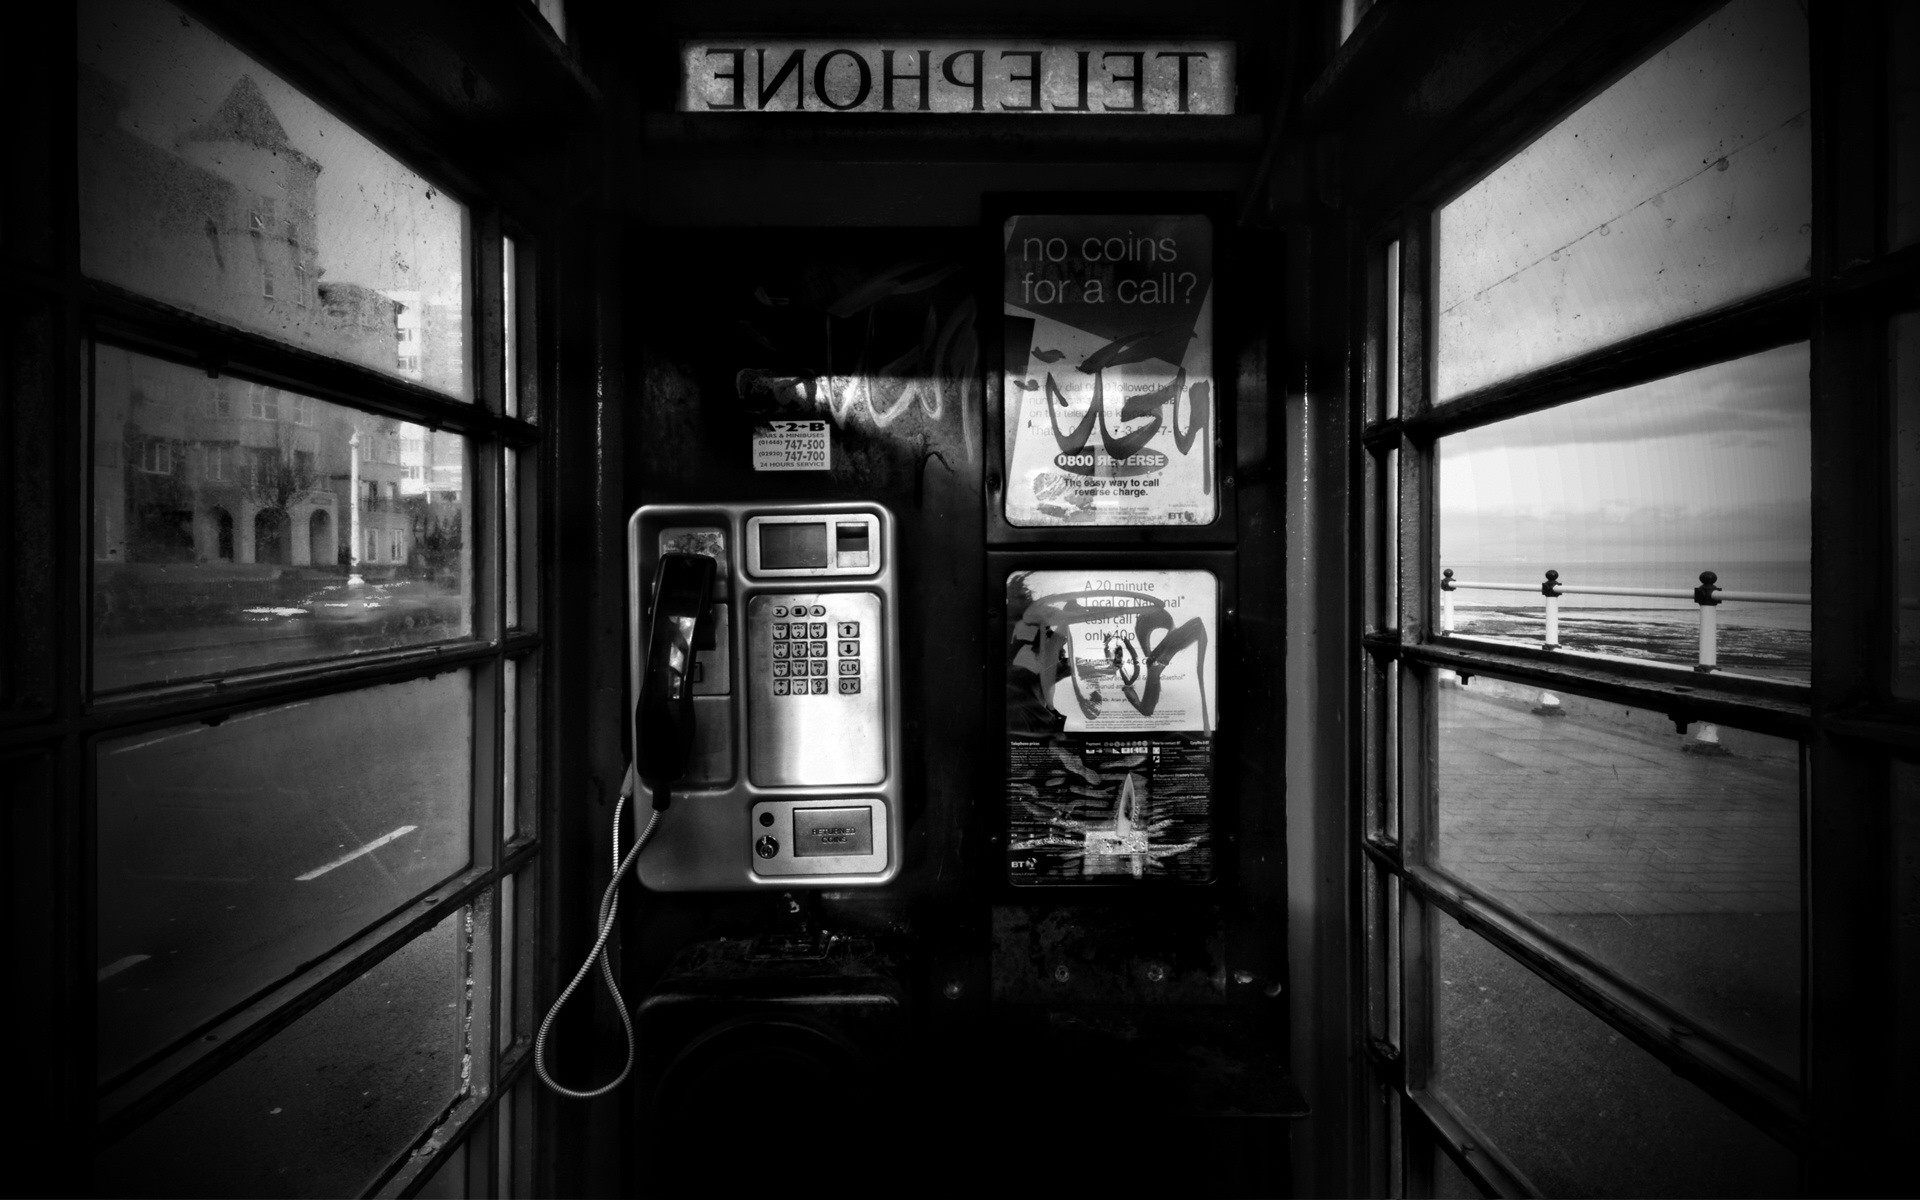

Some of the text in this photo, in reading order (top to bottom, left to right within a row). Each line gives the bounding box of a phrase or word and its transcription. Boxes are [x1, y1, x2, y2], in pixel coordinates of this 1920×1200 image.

[1023, 230, 1177, 262] no coins
[1021, 272, 1197, 304] for a call?
[1065, 382, 1082, 392] dial
[785, 439, 825, 450] 747-500
[785, 451, 825, 461] 747-700
[1057, 454, 1093, 466] 0800
[1064, 478, 1160, 488] The easy way to call
[1112, 488, 1148, 498] charge.
[1168, 512, 1183, 520] BT
[1085, 579, 1155, 592] A 20 minute
[1085, 595, 1115, 608] Local
[1118, 599, 1130, 608] or
[1085, 612, 1110, 625] cash
[1113, 612, 1132, 625] call
[1085, 629, 1135, 644] only 40p
[840, 664, 857, 672] CLR
[811, 827, 856, 836] RETURNED
[821, 836, 847, 844] COINS
